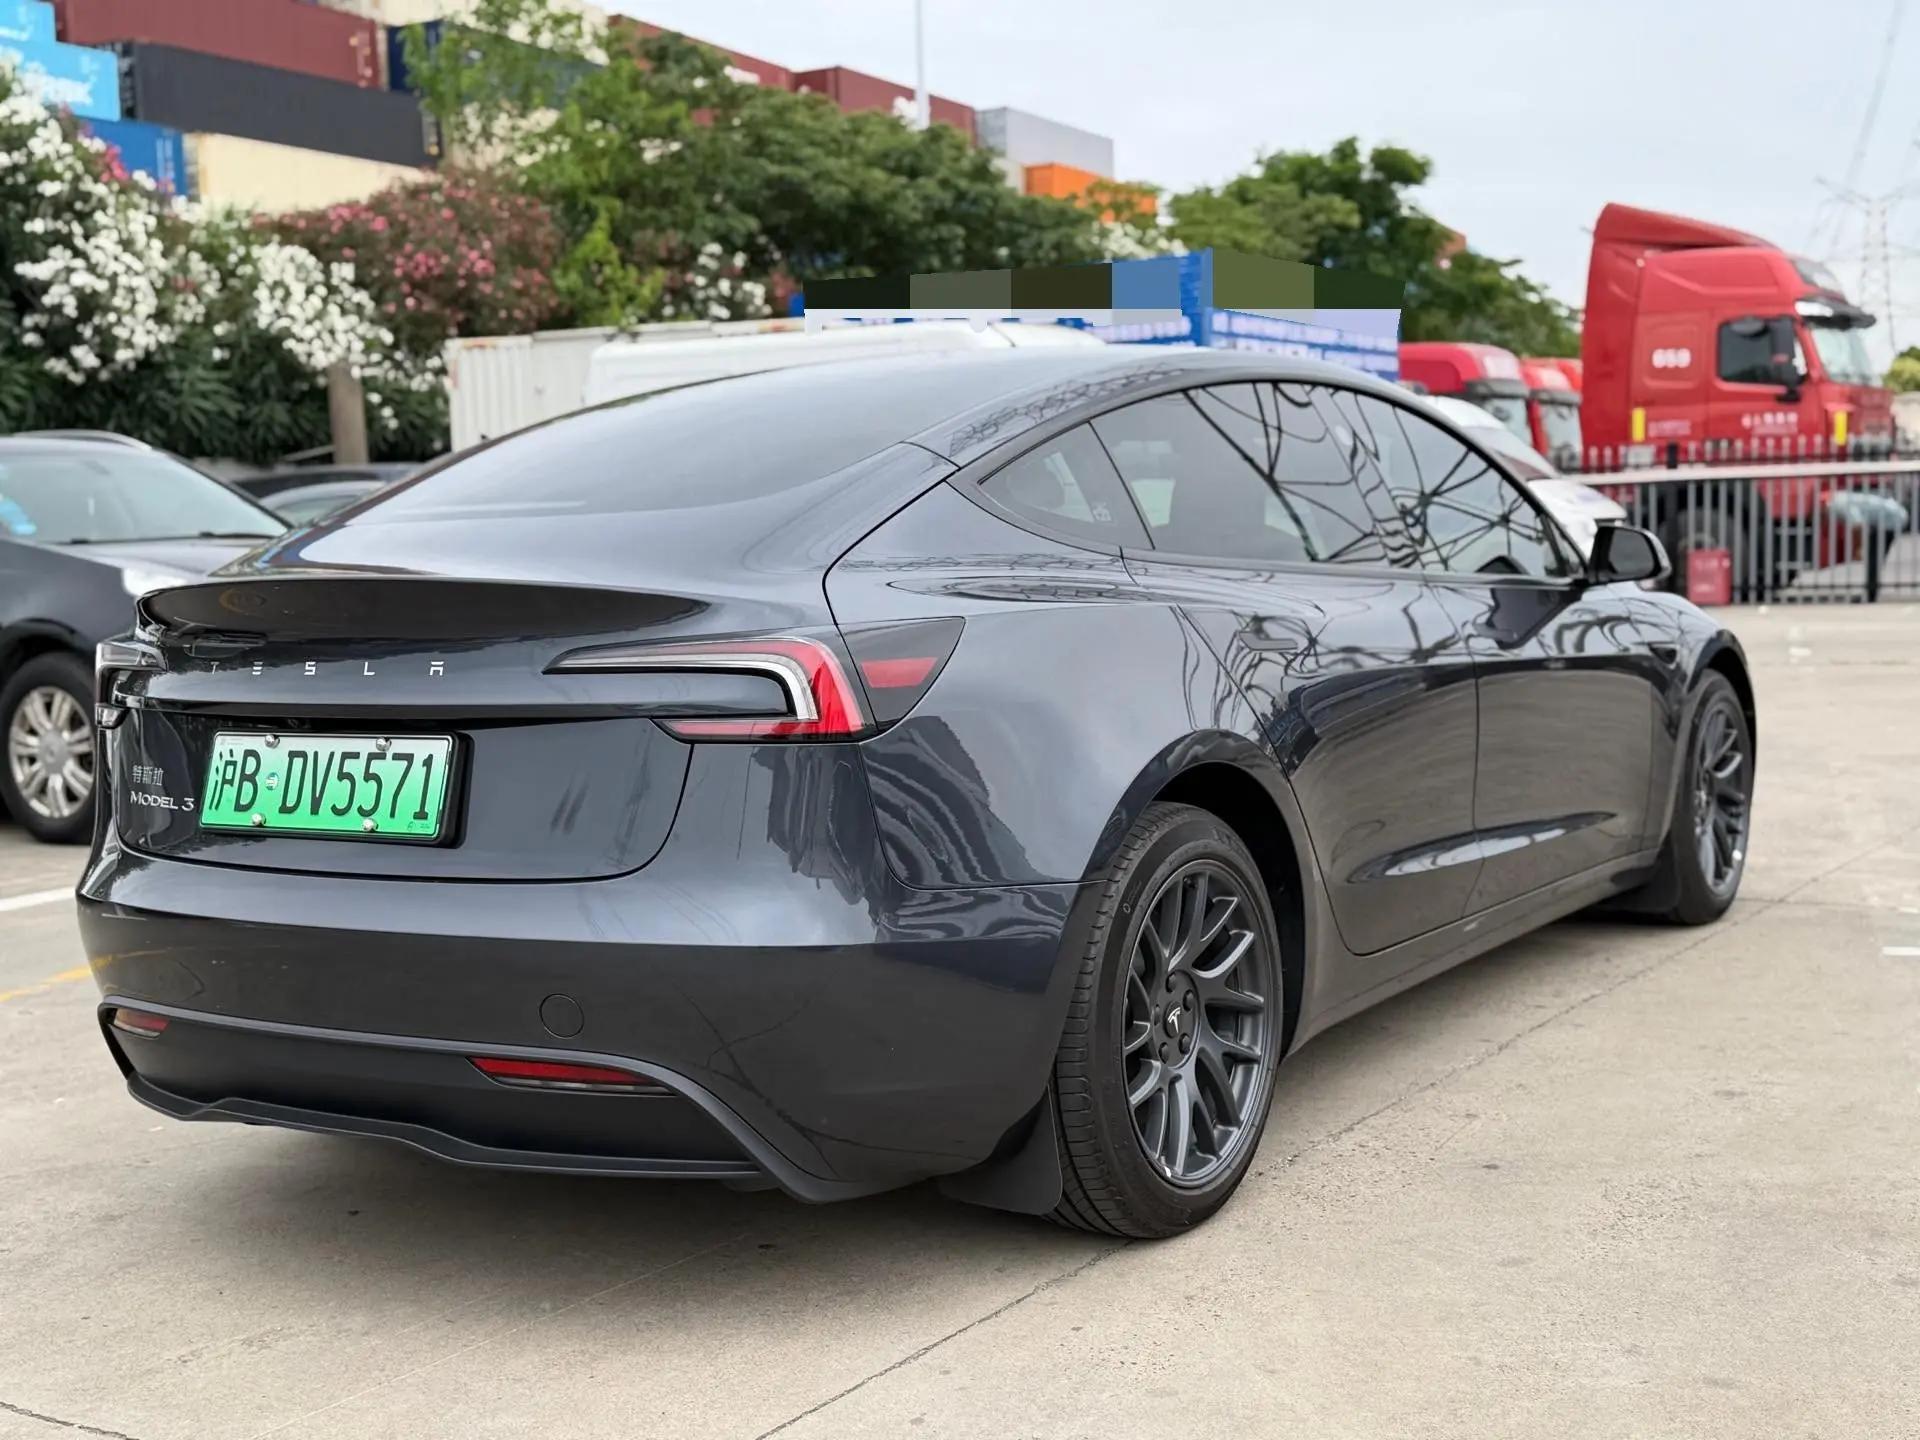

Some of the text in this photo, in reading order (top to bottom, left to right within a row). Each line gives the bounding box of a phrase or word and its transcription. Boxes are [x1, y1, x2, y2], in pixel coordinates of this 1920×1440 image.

[210, 661, 444, 676] TESLA
[132, 765, 164, 786] 特斯拉
[130, 790, 195, 811] MODEL 3
